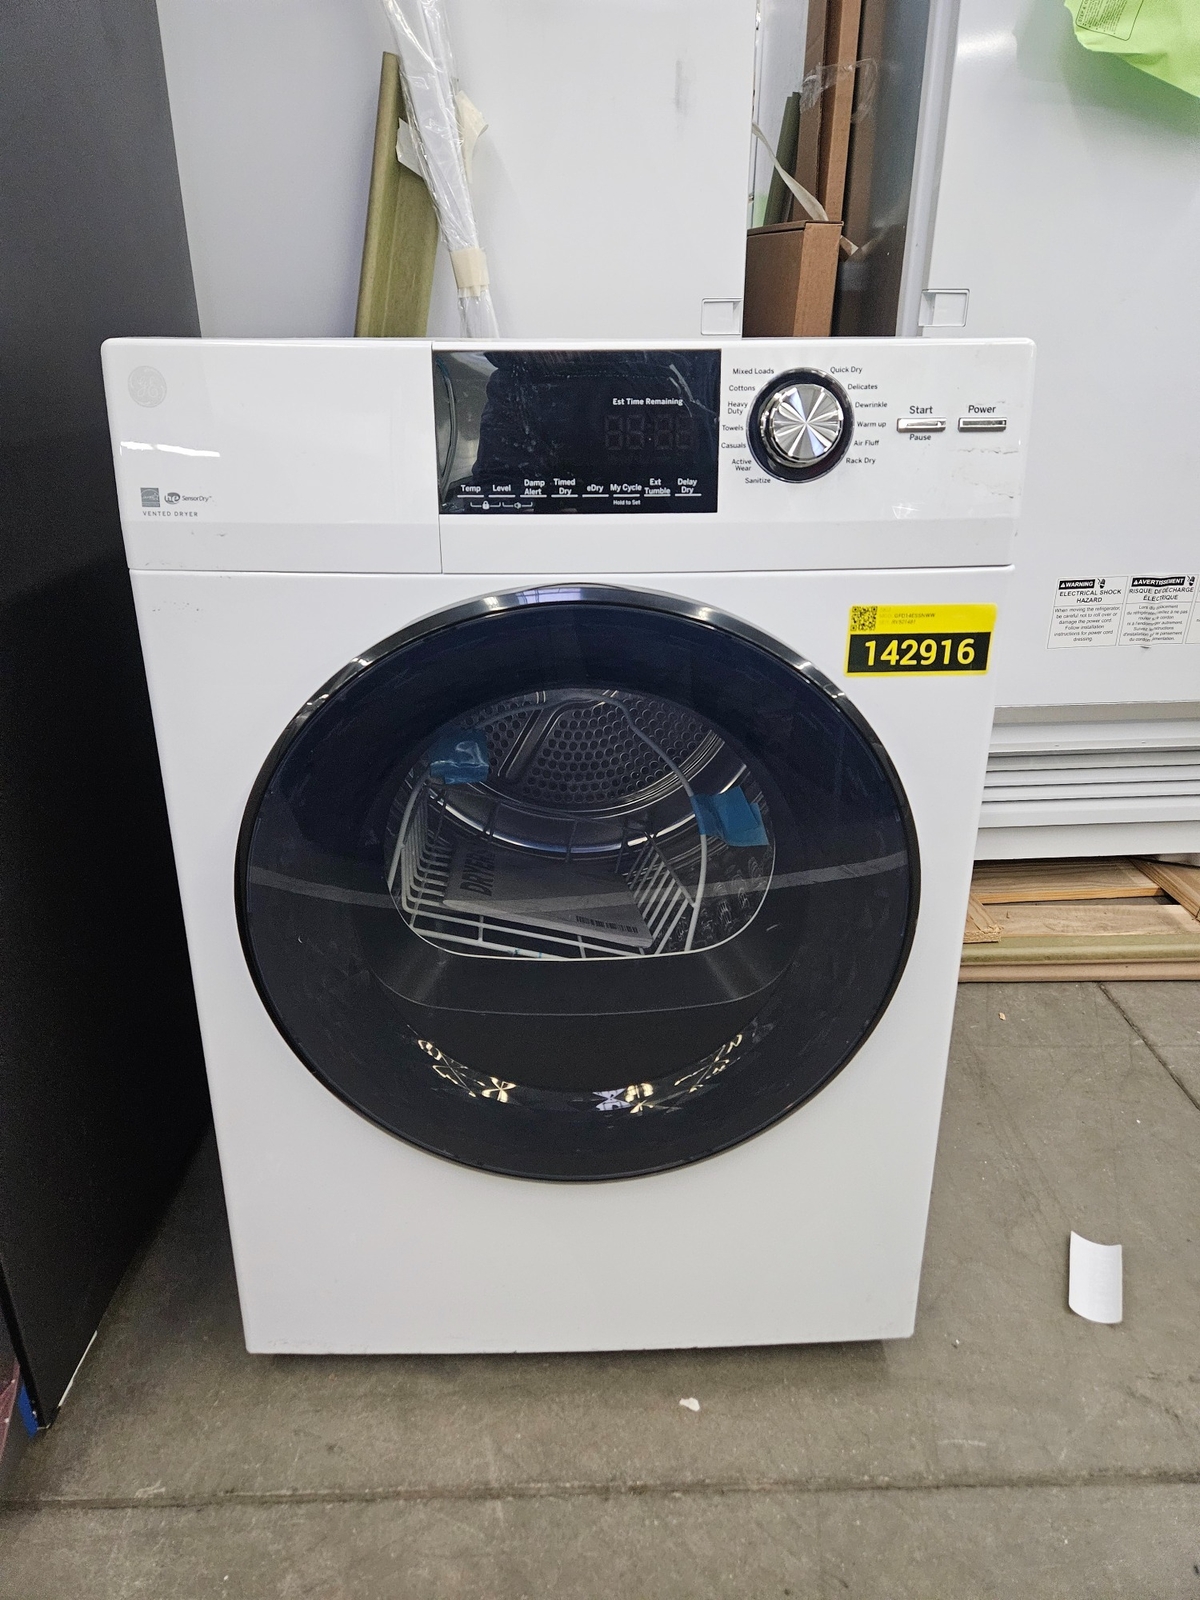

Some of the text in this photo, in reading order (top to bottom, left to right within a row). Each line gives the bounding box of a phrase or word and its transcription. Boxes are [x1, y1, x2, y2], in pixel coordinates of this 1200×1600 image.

[850, 366, 863, 374] Dry
[612, 397, 683, 406] Est Time Remaining
[727, 401, 748, 409] Heavy
[909, 405, 933, 414] Start
[968, 405, 996, 414] Power
[524, 479, 545, 487] Damp
[553, 478, 576, 486] Timed
[649, 478, 662, 486] Ext
[677, 478, 698, 487] Delay
[460, 484, 481, 493] Temp
[492, 484, 512, 492] Level
[558, 487, 572, 495] Dry
[586, 484, 604, 493] eDry
[610, 483, 642, 493] My Cycle
[681, 486, 694, 495] Dry
[865, 638, 975, 666] 142916
